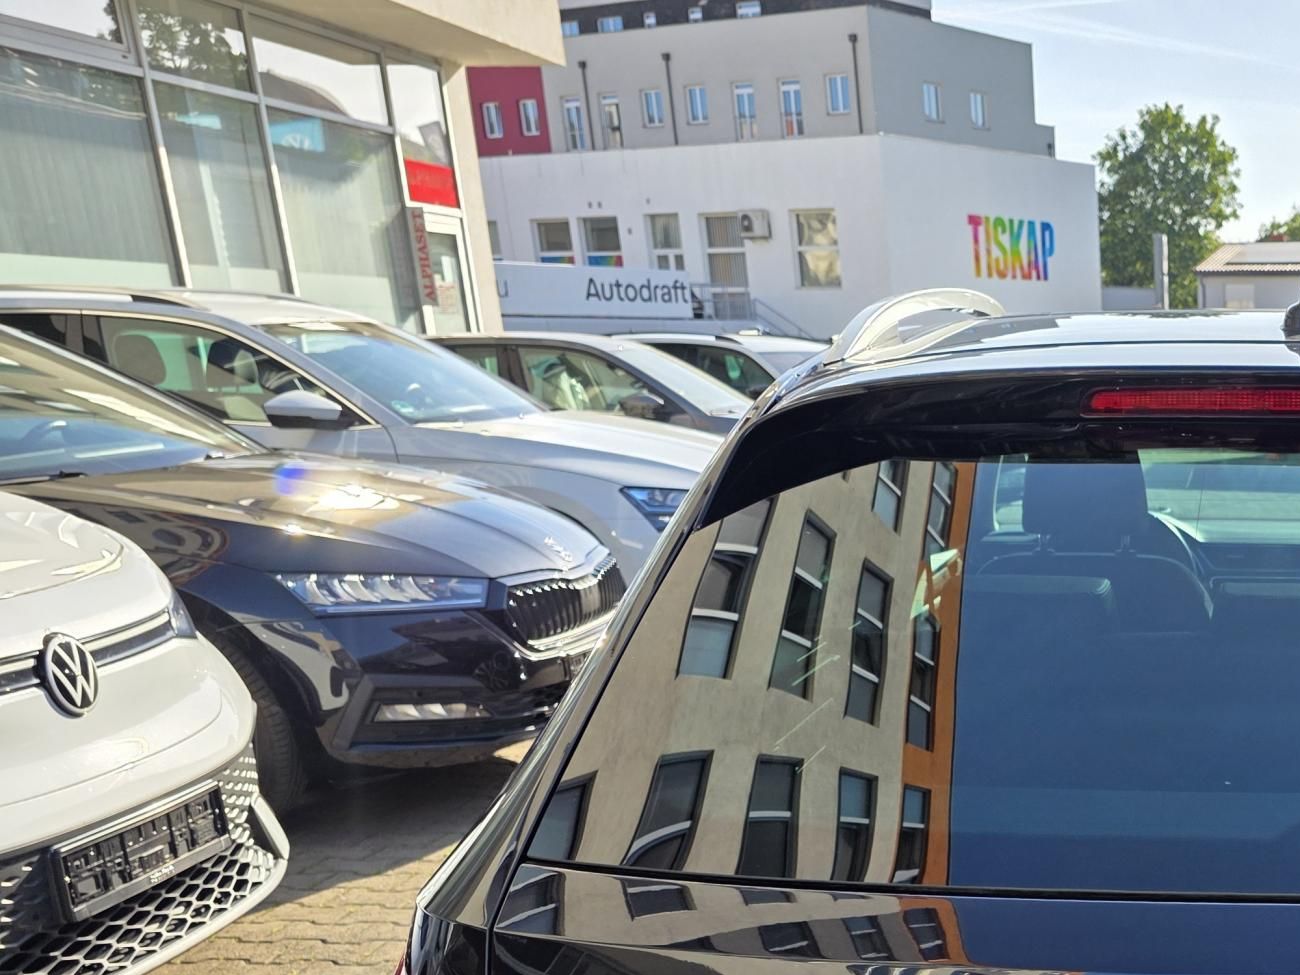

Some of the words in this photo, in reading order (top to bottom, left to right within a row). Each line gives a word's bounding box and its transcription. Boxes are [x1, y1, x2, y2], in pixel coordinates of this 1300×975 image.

[411, 210, 437, 302] ALPHASET
[967, 214, 1055, 281] TISKAP
[586, 277, 689, 304] Autodraft
